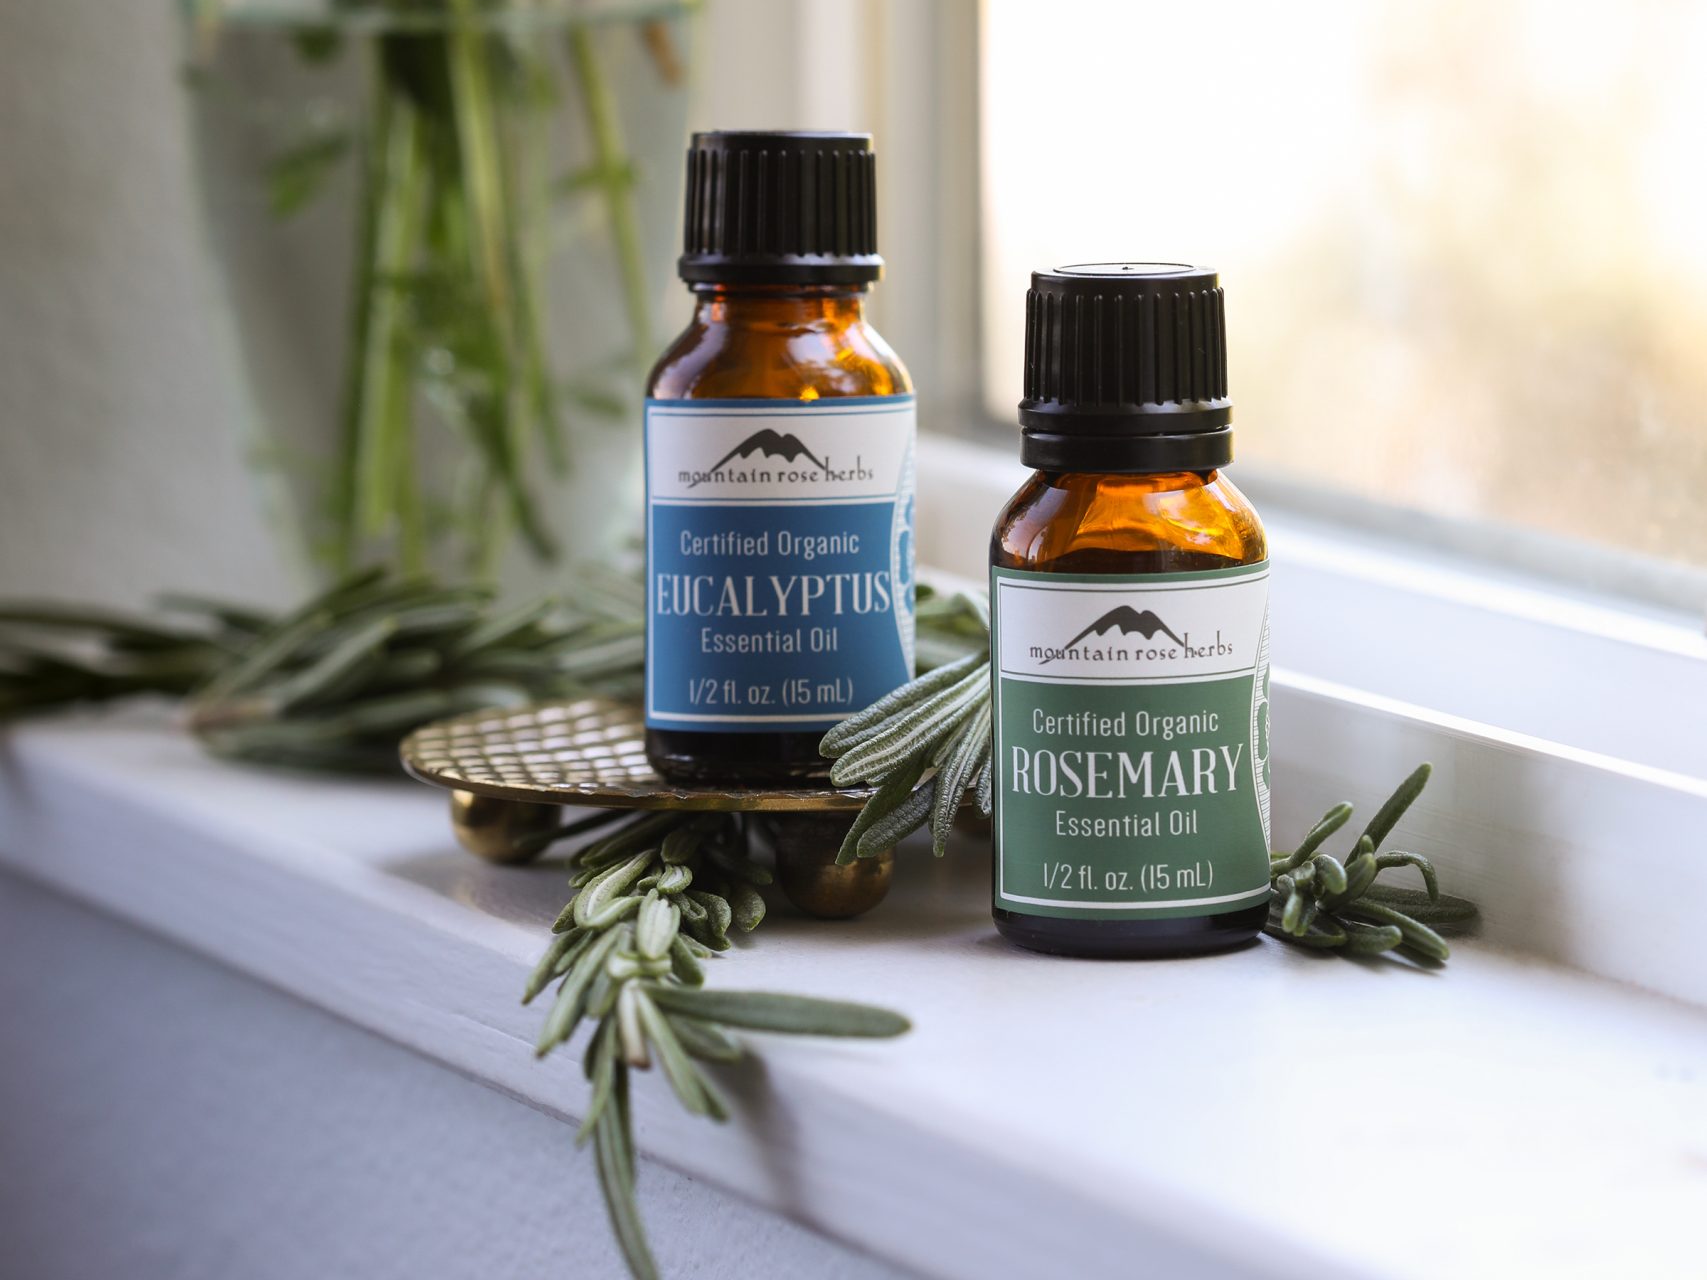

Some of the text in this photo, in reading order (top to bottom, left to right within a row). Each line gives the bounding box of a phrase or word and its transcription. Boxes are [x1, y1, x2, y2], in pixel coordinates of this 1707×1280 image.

[678, 456, 874, 488] mountain rose herbs
[681, 530, 860, 560] Certified Organic
[657, 572, 891, 616] EUCALYPTUS
[701, 628, 838, 653] Essential Oil
[1030, 631, 1233, 664] mountain rose herbs
[689, 679, 853, 706] 1/2 fl. oz. (15 mL)
[1032, 709, 1218, 740] Certified Organic
[1012, 744, 1244, 798] ROSEMARY
[1056, 811, 1197, 837] Essential Oil
[1044, 861, 1213, 893] 1/2 fl. oz. (15 mL)
